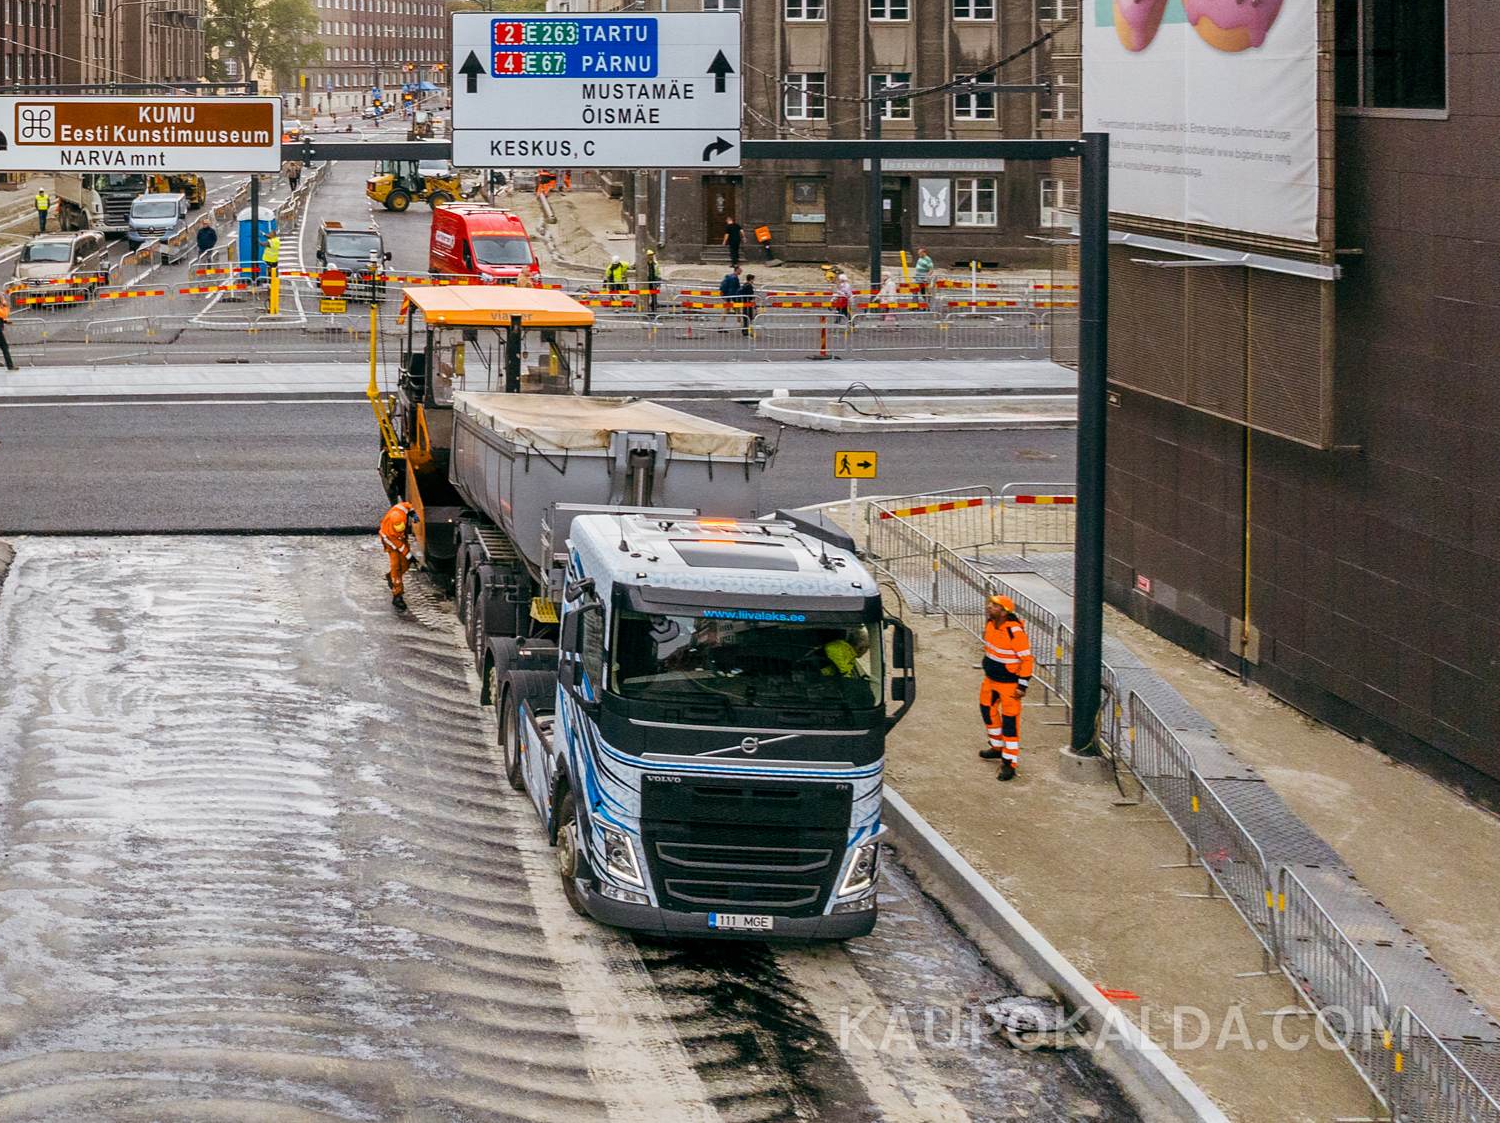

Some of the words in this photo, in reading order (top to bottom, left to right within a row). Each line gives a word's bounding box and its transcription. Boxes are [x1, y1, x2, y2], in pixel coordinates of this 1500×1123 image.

[504, 26, 515, 42] 2
[526, 26, 537, 42] E
[543, 26, 576, 42] 263
[582, 25, 648, 42] TARTU
[503, 56, 515, 71] 4
[526, 56, 537, 72] E
[542, 56, 563, 72] 67
[582, 52, 651, 72] PÄRNU
[582, 79, 695, 100] MUSTAMÄE
[138, 106, 195, 123] KUMU
[582, 104, 660, 124] ÕISMÄE
[60, 124, 108, 142] Eesti
[113, 124, 269, 143] Kunstimuuseum
[490, 140, 578, 158] KESKUS,
[583, 140, 596, 156] C
[60, 150, 126, 166] NARVA
[130, 151, 166, 166] mnt
[703, 609, 806, 623] www.liivalaks.ee
[646, 775, 682, 784] VOLVO
[720, 915, 736, 926] 111
[743, 916, 769, 928] MGE
